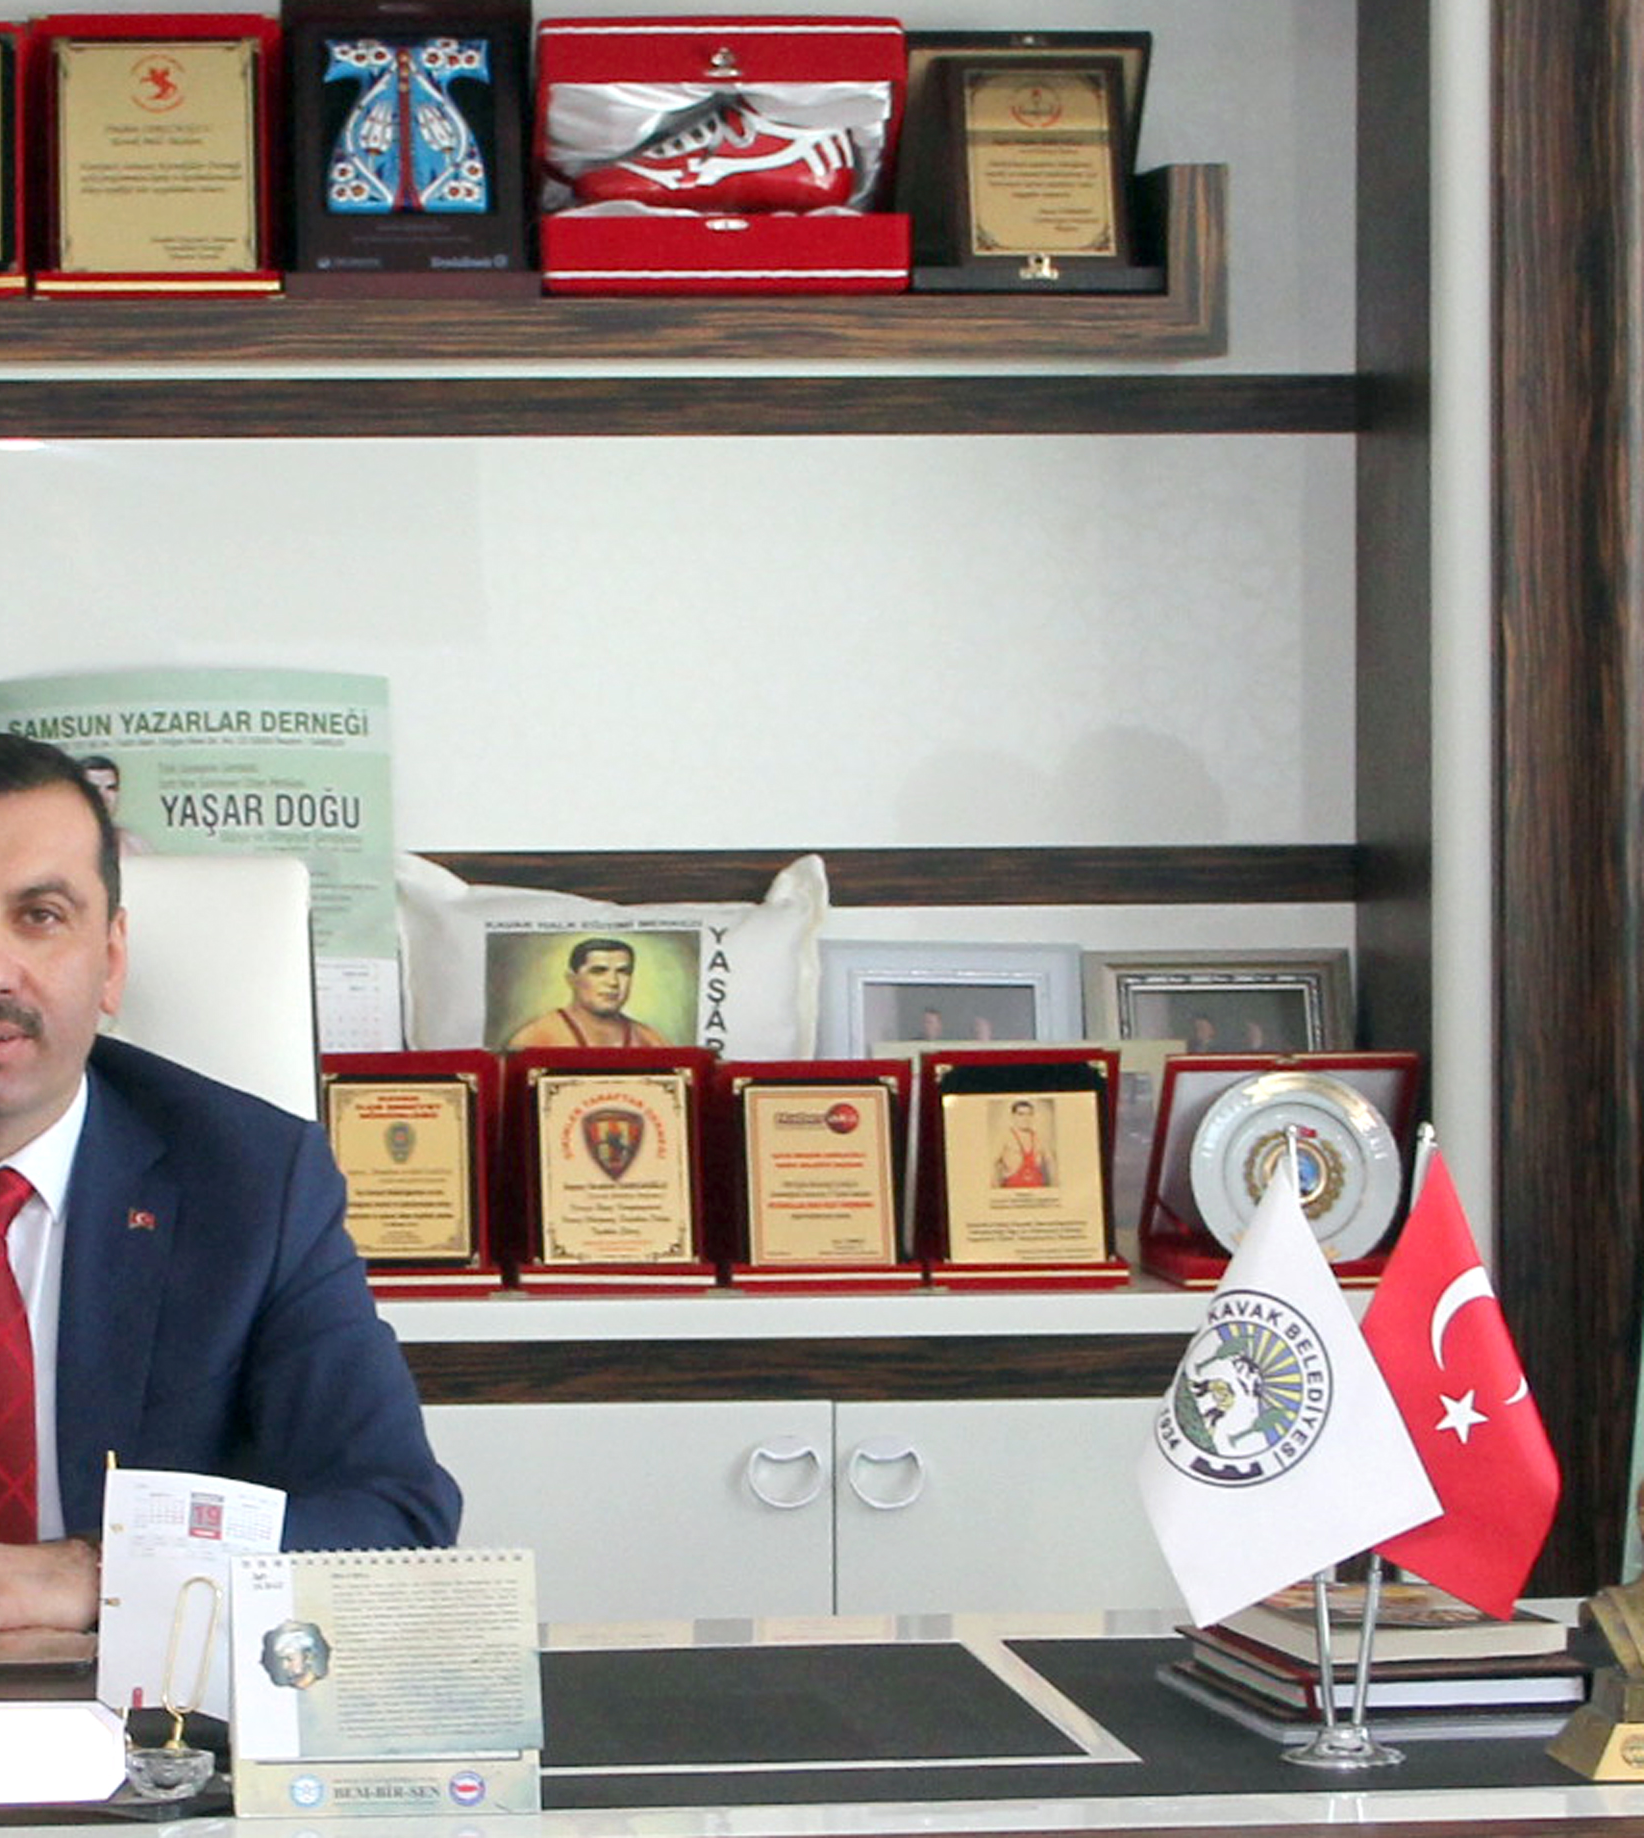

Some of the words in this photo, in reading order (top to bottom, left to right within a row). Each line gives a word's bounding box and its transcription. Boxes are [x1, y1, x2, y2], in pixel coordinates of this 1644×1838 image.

[9, 714, 112, 739] SAMSUN
[120, 711, 252, 735] YAZARLAR
[260, 708, 369, 735] DERNEĞİ
[160, 794, 264, 835] YAŞAR
[275, 788, 361, 828] DOĞU
[1207, 1300, 1284, 1327] KAVAK
[1273, 1323, 1324, 1469] BELEDİYESİ
[1160, 1408, 1182, 1451] 1934
